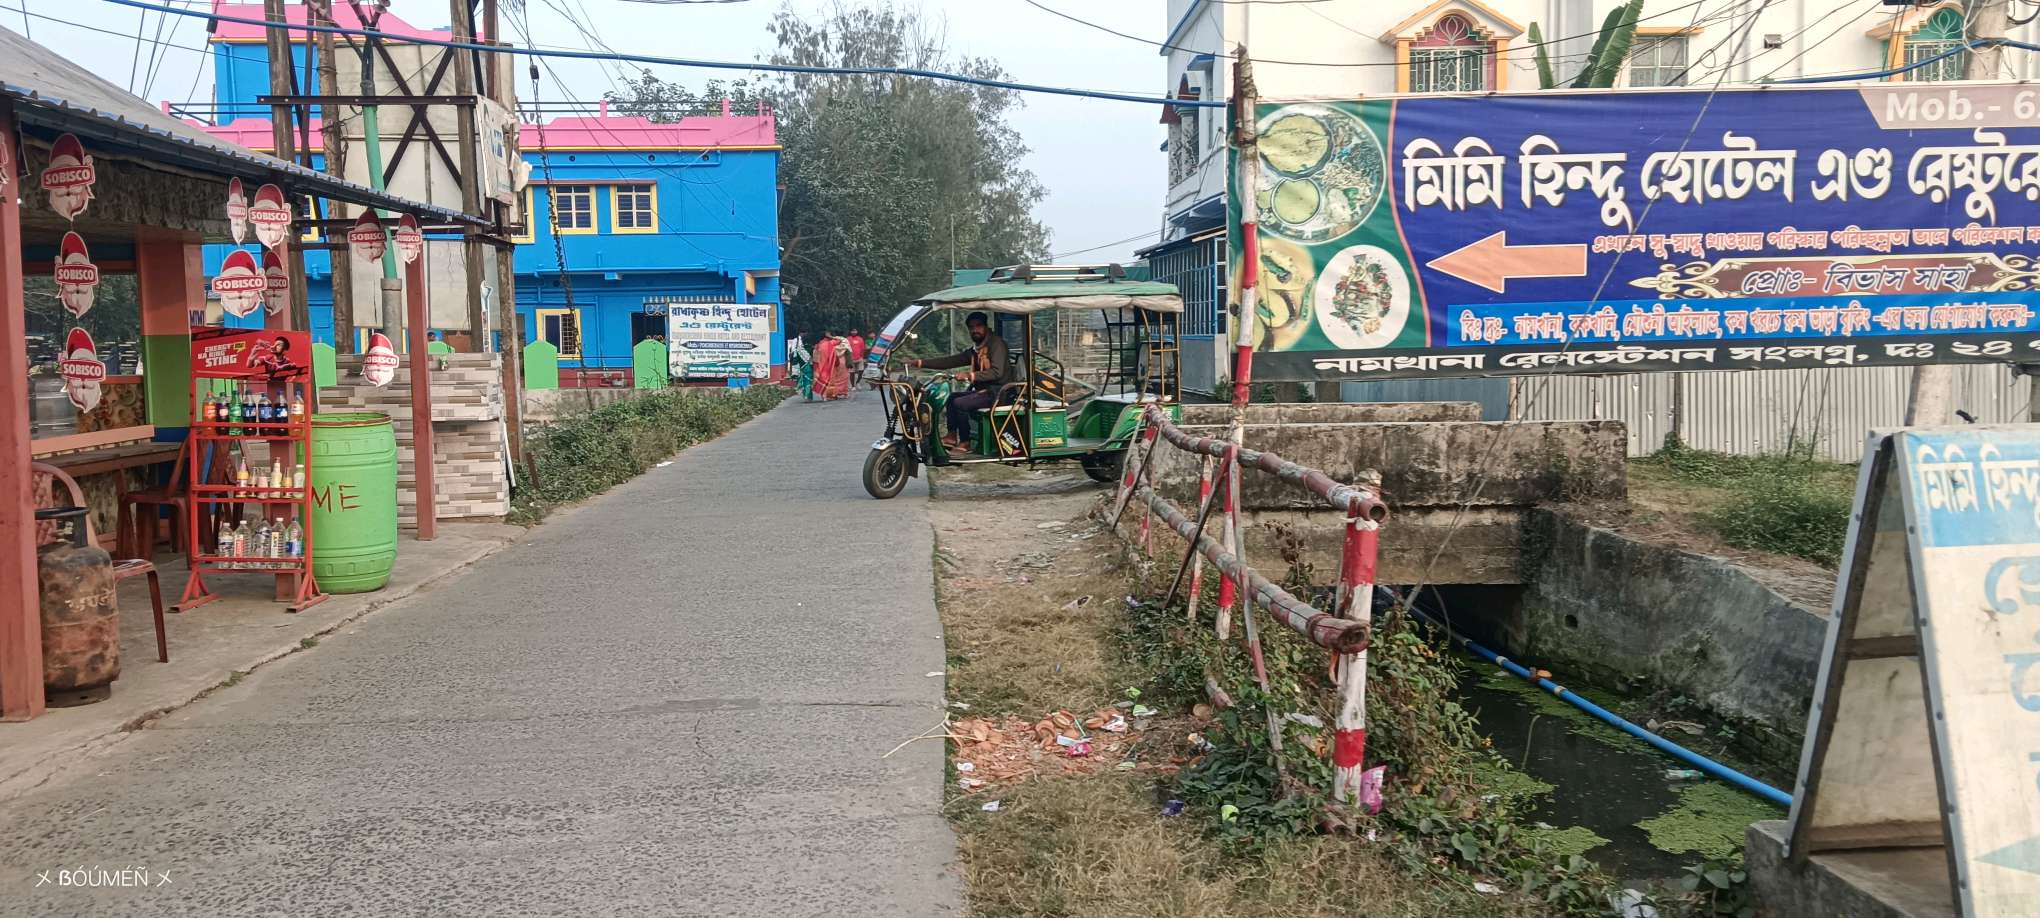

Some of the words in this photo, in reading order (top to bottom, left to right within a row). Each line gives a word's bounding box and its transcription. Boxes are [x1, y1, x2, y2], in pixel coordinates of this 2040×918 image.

[45, 168, 91, 185] SOBISCO
[1402, 137, 1506, 213] মিমি
[1519, 134, 1635, 233] হিন্দু
[1640, 131, 1797, 205] হোটেল
[251, 211, 288, 221] SOBISCO
[1592, 233, 1647, 254] এখানে
[1706, 232, 1764, 252] খাওয়ার
[1912, 228, 1950, 246] ভাবে
[1952, 223, 2025, 247] পরিবেশন
[58, 268, 94, 281] SOBISCO
[1823, 262, 1910, 293] বিভাস
[1913, 263, 1975, 291] সাহা
[215, 278, 263, 290] SOBISCO
[712, 304, 733, 321] হিন্দু
[736, 306, 767, 317] হোটেল
[205, 354, 238, 368] STING
[1312, 353, 1486, 374] নামখানা
[1951, 341, 2013, 357] ২৪
[1917, 443, 1980, 513] মিমি
